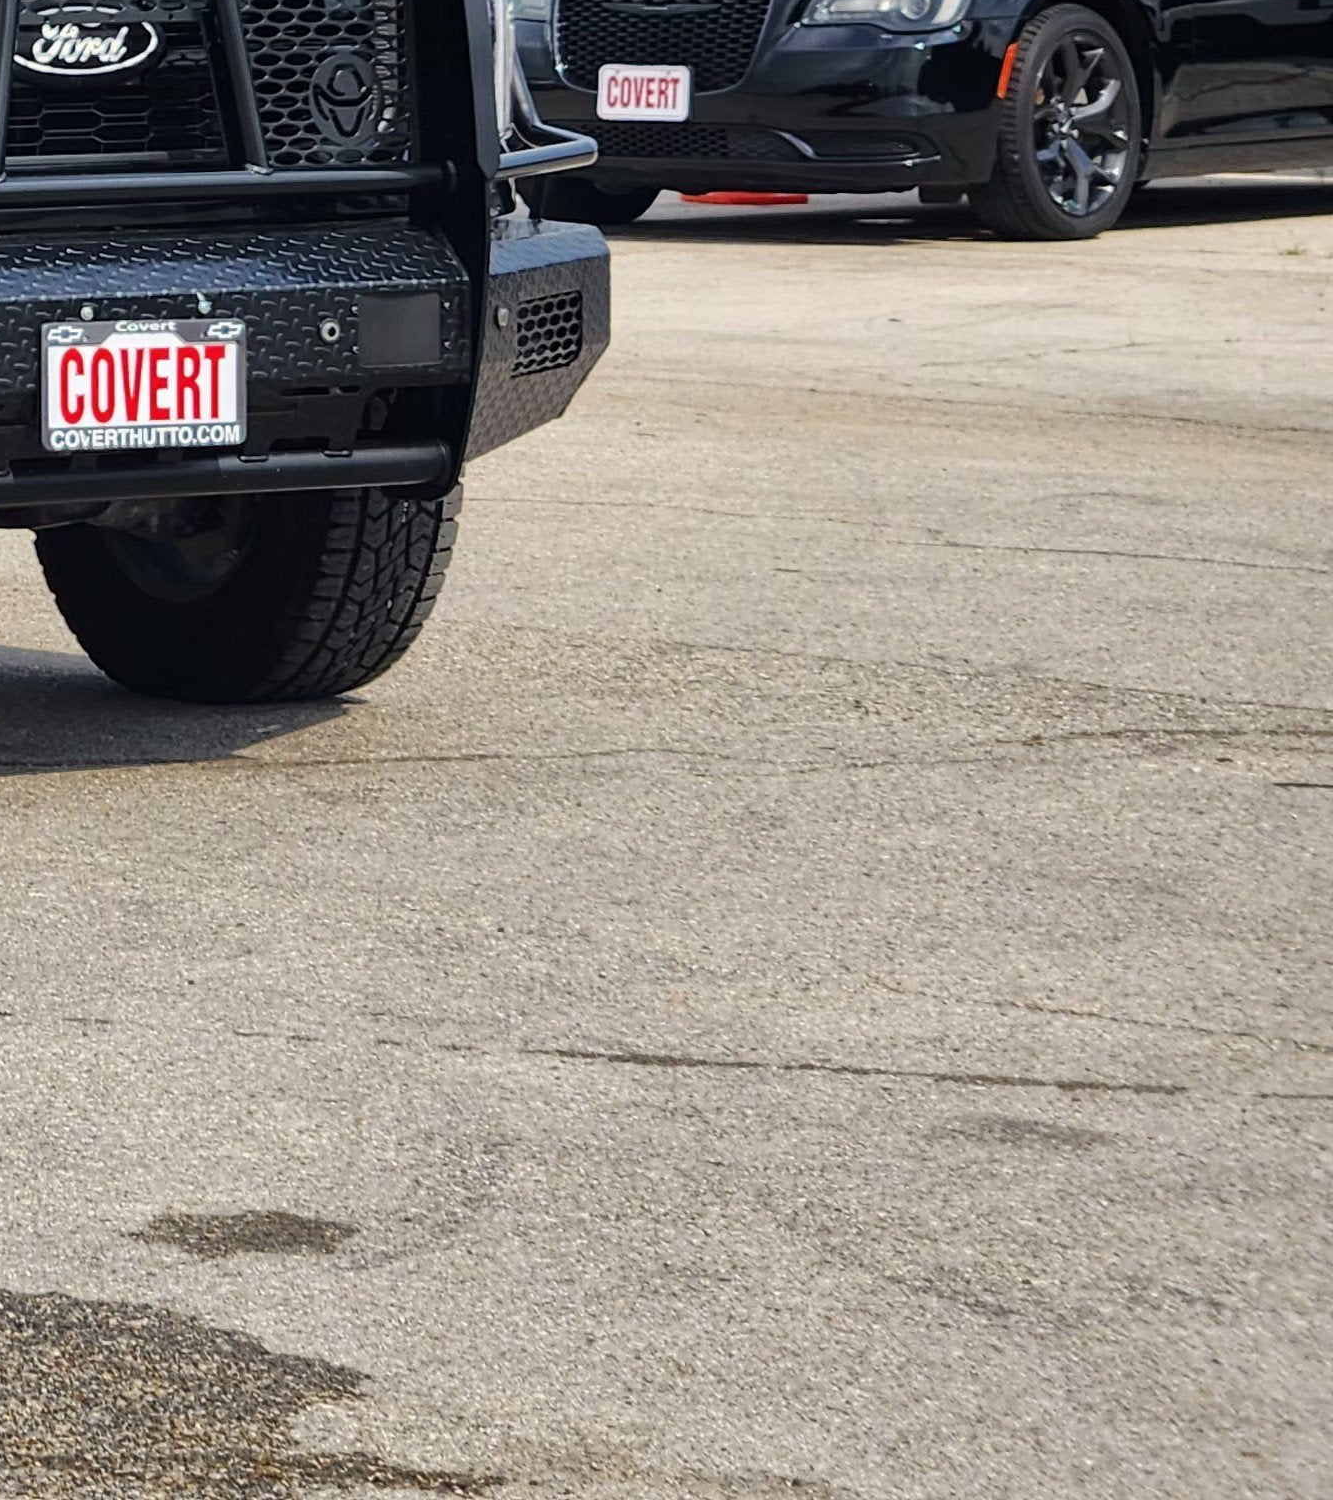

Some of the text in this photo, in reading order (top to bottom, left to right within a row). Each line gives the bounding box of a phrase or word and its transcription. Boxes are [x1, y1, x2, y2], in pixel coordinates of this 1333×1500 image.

[32, 22, 130, 64] Ford
[606, 75, 680, 110] COVERT
[114, 320, 177, 332] Covert
[59, 344, 226, 425] COVERT
[49, 424, 241, 451] COVERTHUTTO.COM
